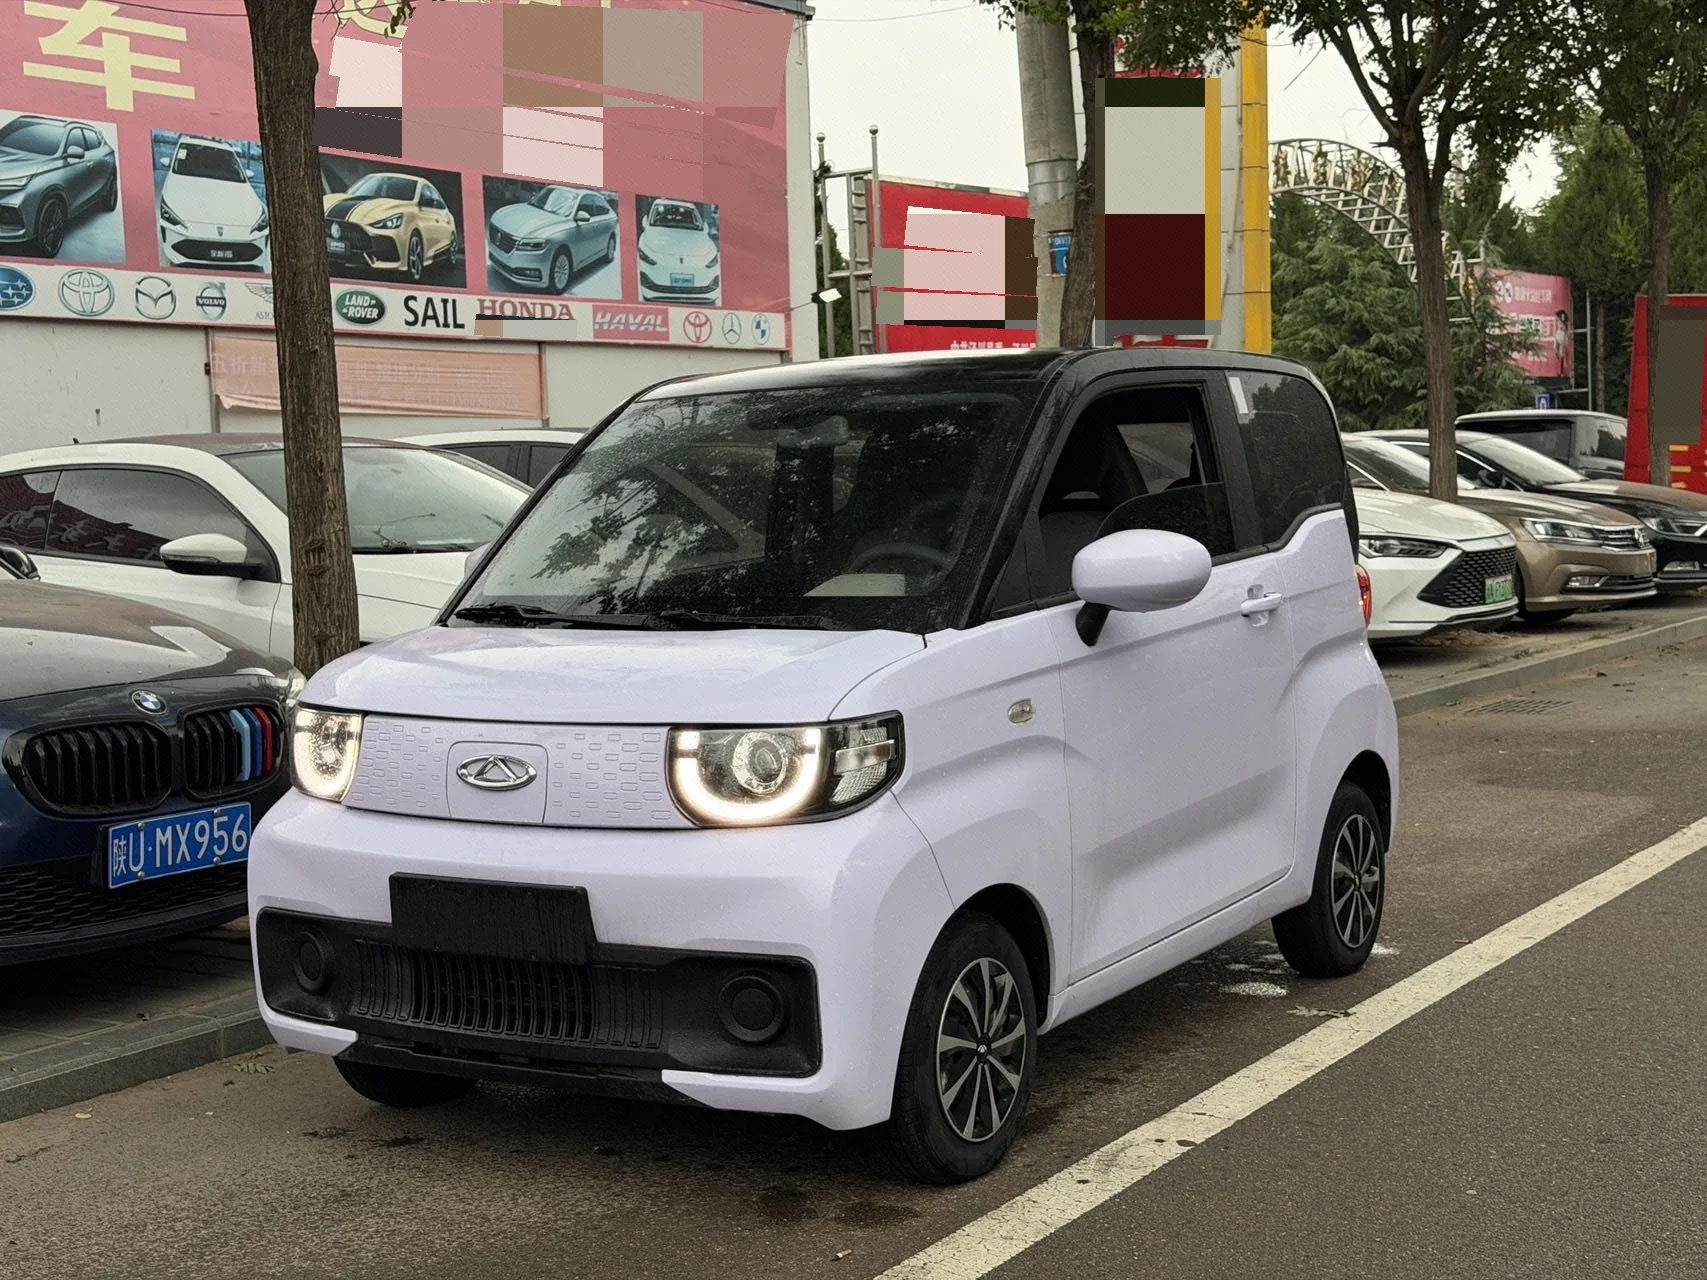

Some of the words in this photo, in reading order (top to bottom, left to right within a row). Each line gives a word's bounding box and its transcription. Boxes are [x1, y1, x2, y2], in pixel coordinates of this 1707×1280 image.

[197, 298, 225, 306] VOLVO
[345, 294, 371, 306] LAND
[347, 307, 379, 319] ROVER
[403, 295, 465, 329] SAIL
[477, 298, 576, 320] HONDA
[593, 311, 668, 332] HAVAL
